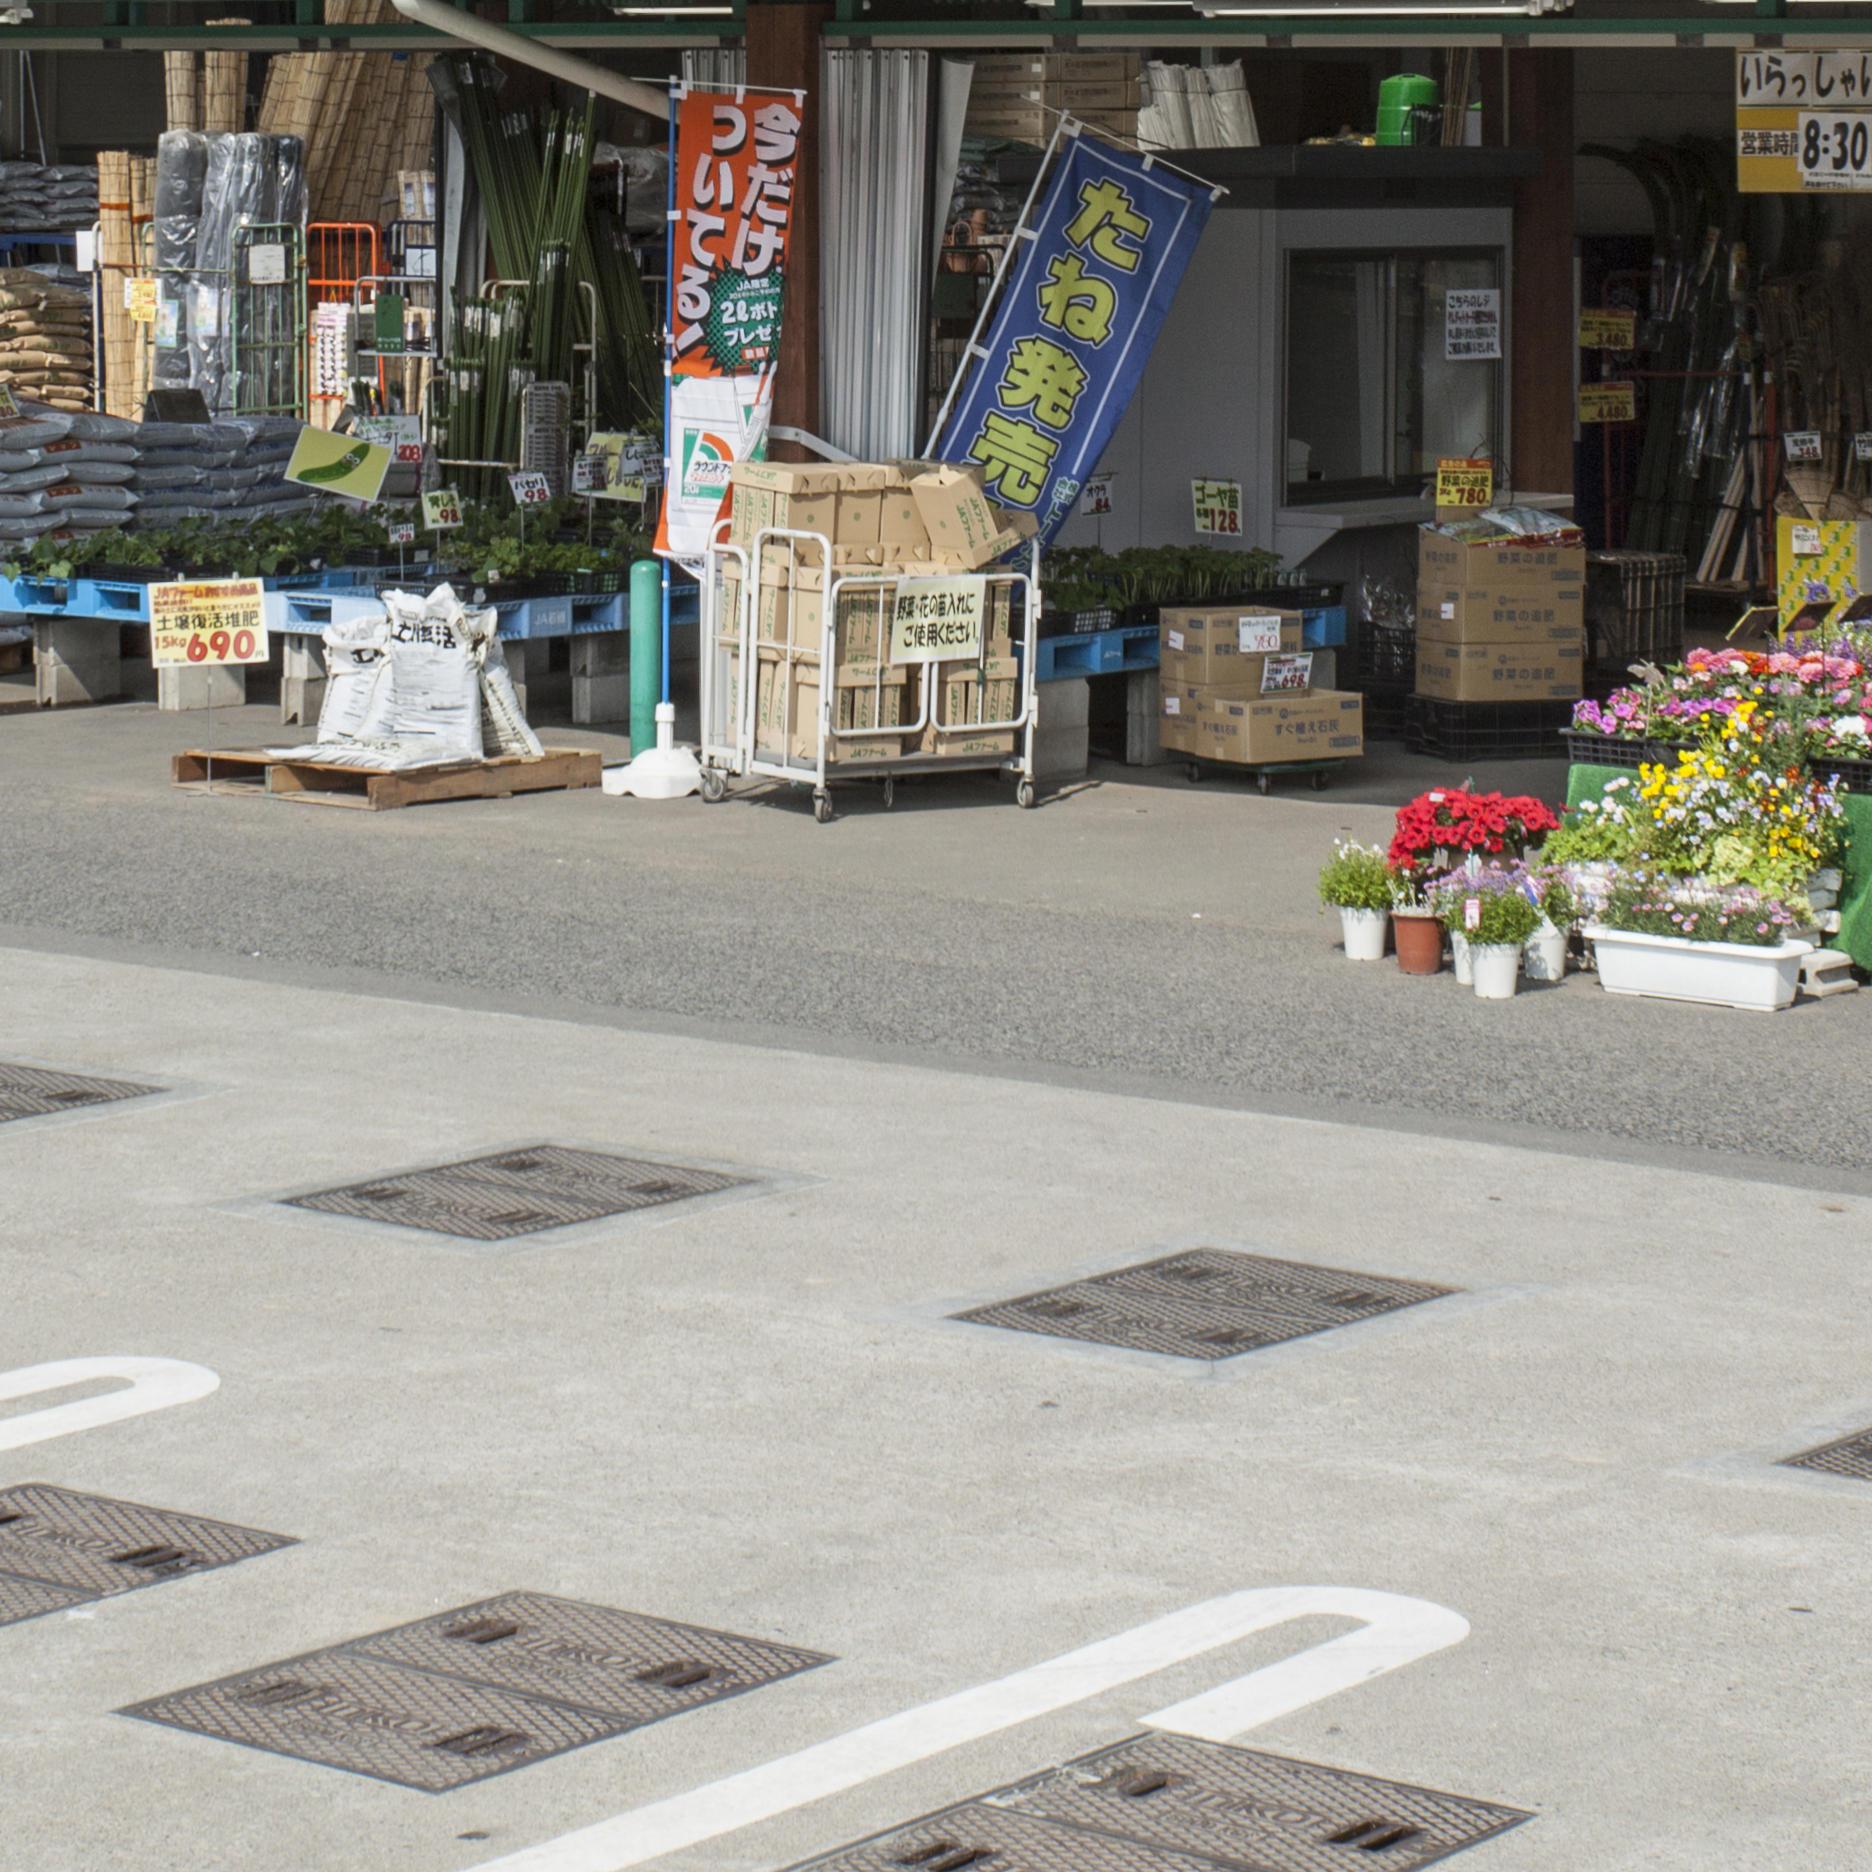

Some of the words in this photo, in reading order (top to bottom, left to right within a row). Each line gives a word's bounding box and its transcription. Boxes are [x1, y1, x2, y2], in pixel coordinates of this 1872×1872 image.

[1802, 119, 1869, 172] 8:30
[969, 178, 1152, 510] たね発売
[523, 487, 548, 502] 98
[1194, 483, 1240, 509] ゴーヤ苗
[1455, 486, 1487, 505] 780
[439, 509, 461, 523] 98
[1209, 508, 1239, 533] 128
[1497, 551, 1559, 566] 野菜の追肥
[155, 609, 260, 632] 土壌復活堆肥
[1492, 609, 1555, 623] 野菜の追肥
[154, 635, 187, 650] 15kg
[1492, 668, 1556, 681] 野菜の追肥
[1275, 719, 1340, 737] すぐ植え石灰
